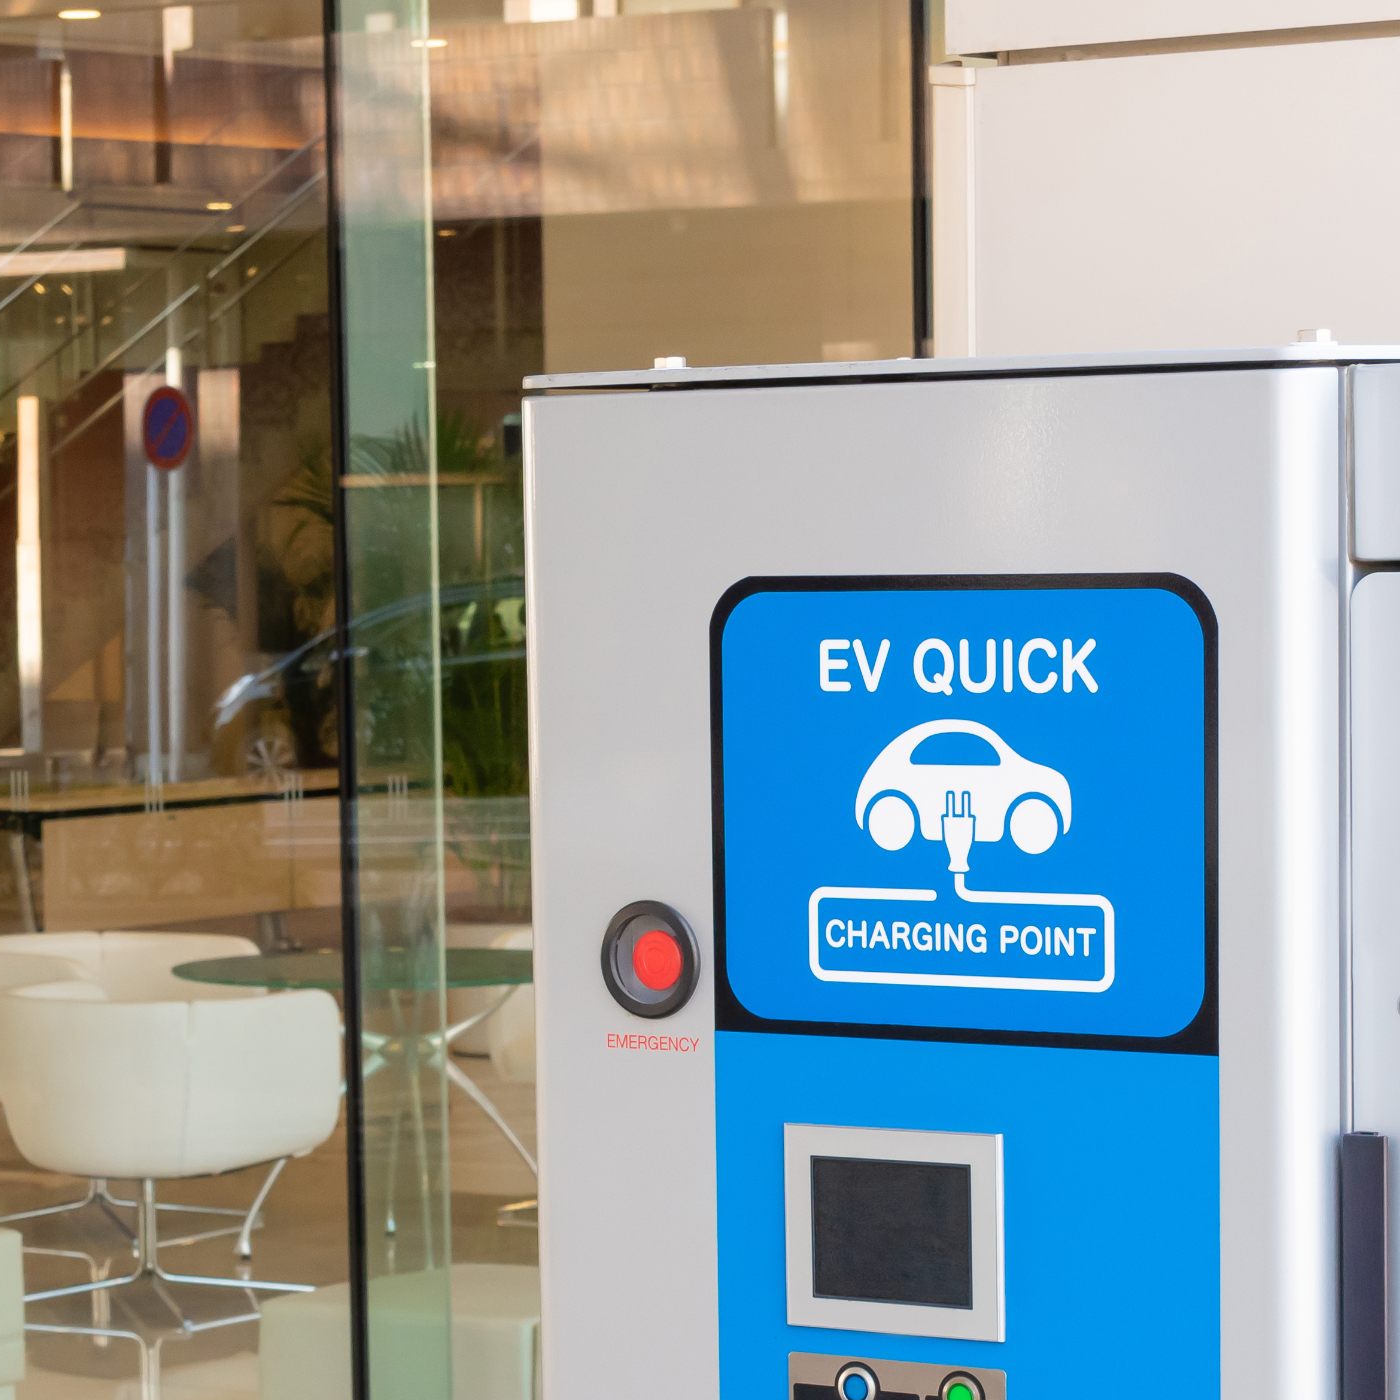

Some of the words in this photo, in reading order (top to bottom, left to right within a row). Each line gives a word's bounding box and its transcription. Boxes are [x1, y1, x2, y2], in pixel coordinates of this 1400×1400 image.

[819, 638, 891, 693] EV
[913, 637, 1099, 696] QUICK
[825, 918, 988, 954] CHARGING
[999, 924, 1097, 957] POINT
[606, 1033, 700, 1053] EMERGENCY
